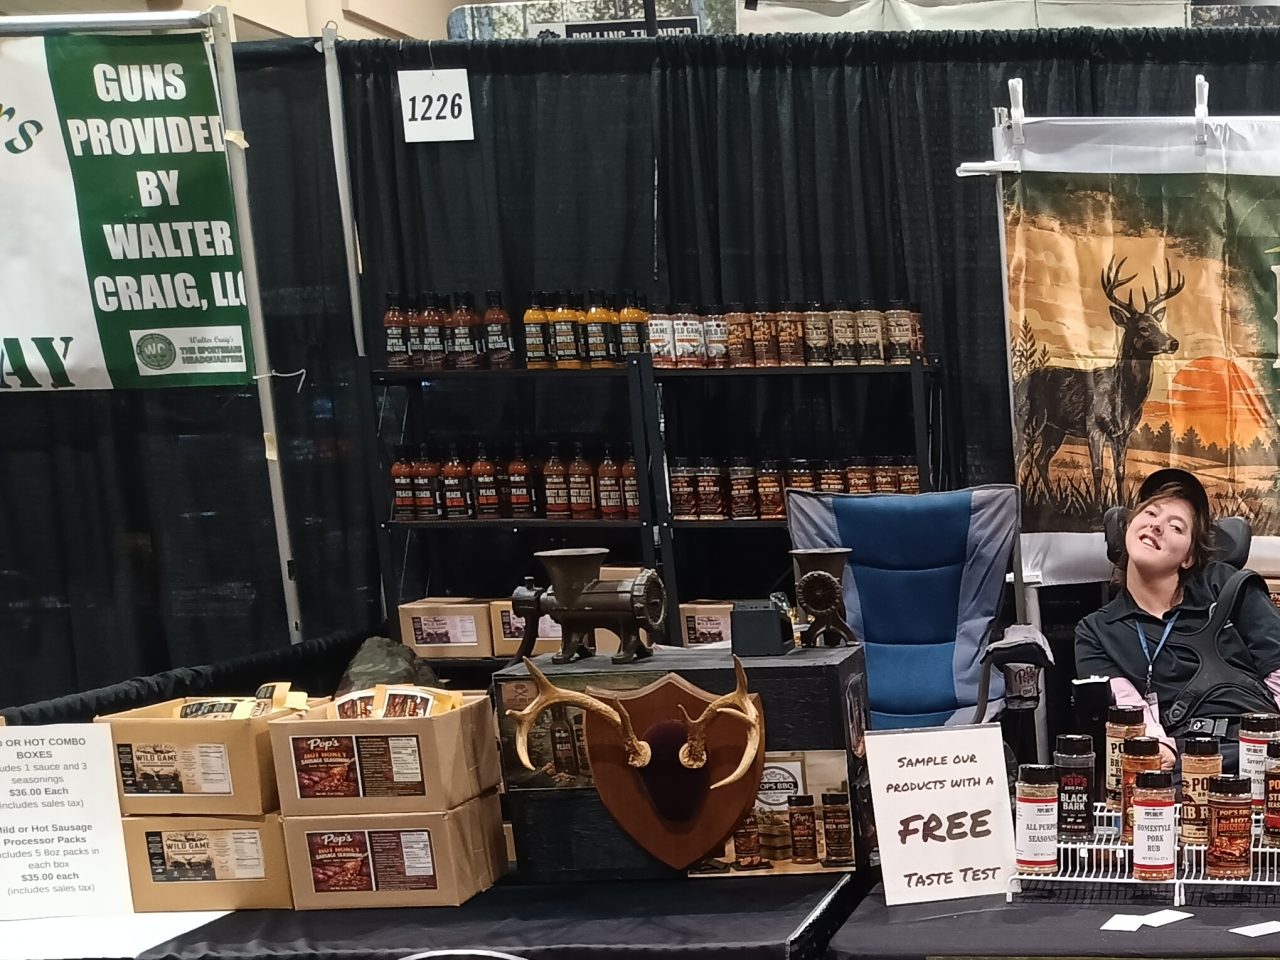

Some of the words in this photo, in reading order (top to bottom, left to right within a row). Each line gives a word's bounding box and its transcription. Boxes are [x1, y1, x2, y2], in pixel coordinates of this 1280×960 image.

[93, 63, 186, 101] GUNS
[408, 93, 463, 121] 1226
[67, 116, 224, 156] PROVIDED
[136, 170, 179, 207] BY
[103, 221, 233, 259] WALTER
[94, 273, 207, 312] CRAIG,
[48, 738, 86, 746] COMBO
[308, 738, 340, 750] Pop's
[17, 751, 53, 759] BOXES
[898, 756, 947, 768] SAMPLE
[953, 754, 977, 764] OUR
[11, 776, 64, 785] seasonings
[886, 780, 946, 793] PRODUCTS
[950, 778, 980, 788] WITH
[985, 777, 994, 786] A
[9, 789, 41, 797] $36.00
[1061, 793, 1087, 802] BLACK
[1063, 803, 1085, 811] BARK
[898, 809, 992, 844] FREE
[1137, 824, 1171, 832] HOMESTYLE
[4, 837, 54, 846] Processor
[57, 836, 86, 844] Packs
[22, 874, 53, 882] $35.00
[904, 871, 953, 888] TASTE
[959, 867, 1001, 881] TEST
